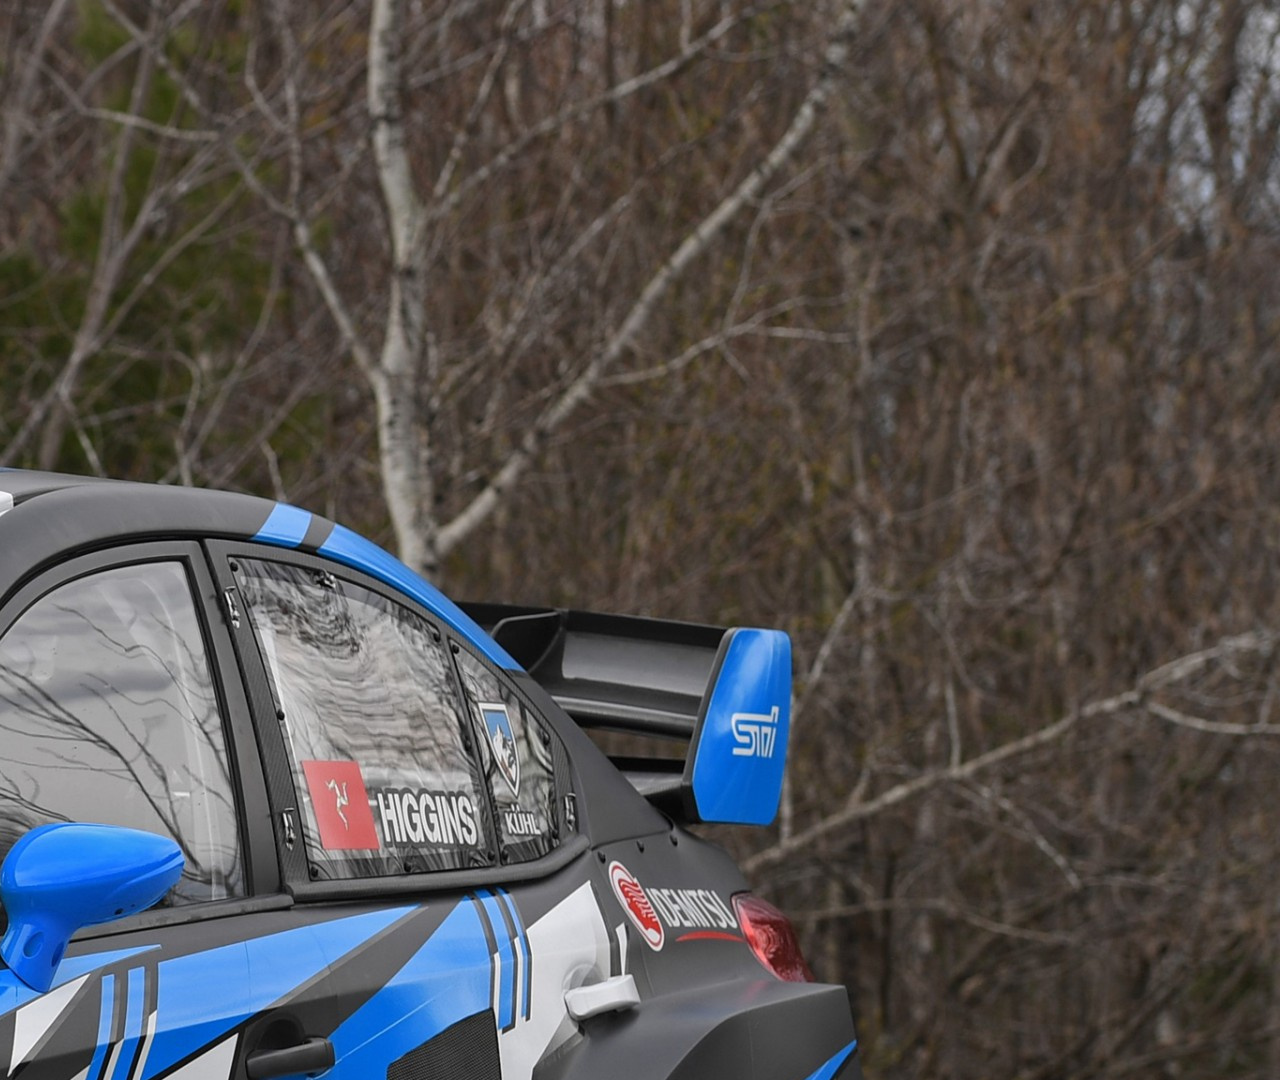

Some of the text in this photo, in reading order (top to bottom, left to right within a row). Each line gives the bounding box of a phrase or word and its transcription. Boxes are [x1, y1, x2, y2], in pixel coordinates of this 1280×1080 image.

[377, 792, 478, 845] HIGGINS
[505, 804, 541, 835] KÜHL
[646, 888, 738, 929] IDEMITSU
